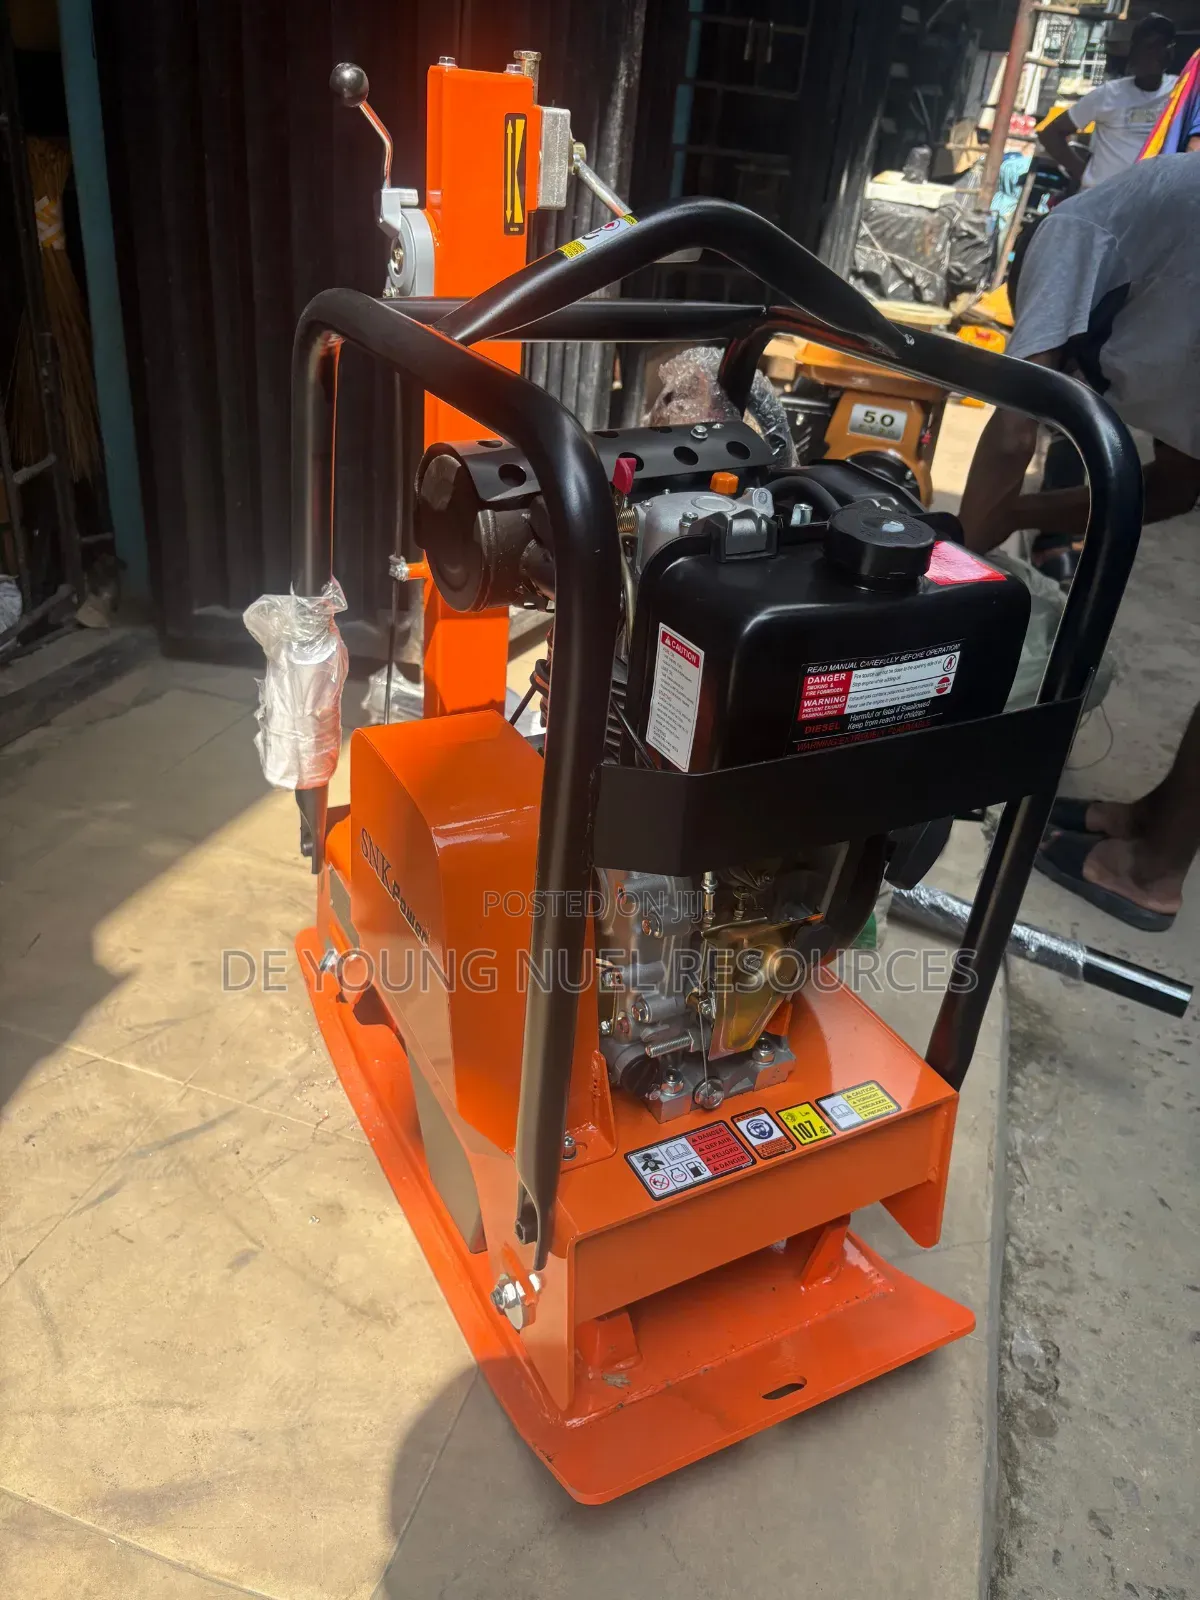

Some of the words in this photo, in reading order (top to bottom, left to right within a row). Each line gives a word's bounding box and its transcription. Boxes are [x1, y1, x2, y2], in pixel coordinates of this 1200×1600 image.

[672, 640, 697, 663] CAUTION
[807, 665, 828, 674] READ
[828, 662, 858, 672] MANUAL
[860, 656, 900, 668] CAREFULLY
[900, 650, 925, 662] BEFORE
[807, 672, 846, 684] DANGER
[817, 687, 843, 695] FORBIDDEN
[803, 695, 846, 707] WARNING
[850, 711, 874, 722] Harmful
[901, 699, 931, 712] Swallowed
[804, 720, 840, 734] DIESEL
[848, 721, 863, 730] Keep
[879, 716, 895, 724] reach
[903, 710, 926, 719] children
[361, 827, 392, 900] SNK
[698, 1128, 724, 1140] DANGER
[792, 1120, 818, 1140] 107
[705, 1137, 731, 1150] GEFAHR
[711, 1146, 739, 1160] PELIGRO
[719, 1156, 746, 1169] DANGER
